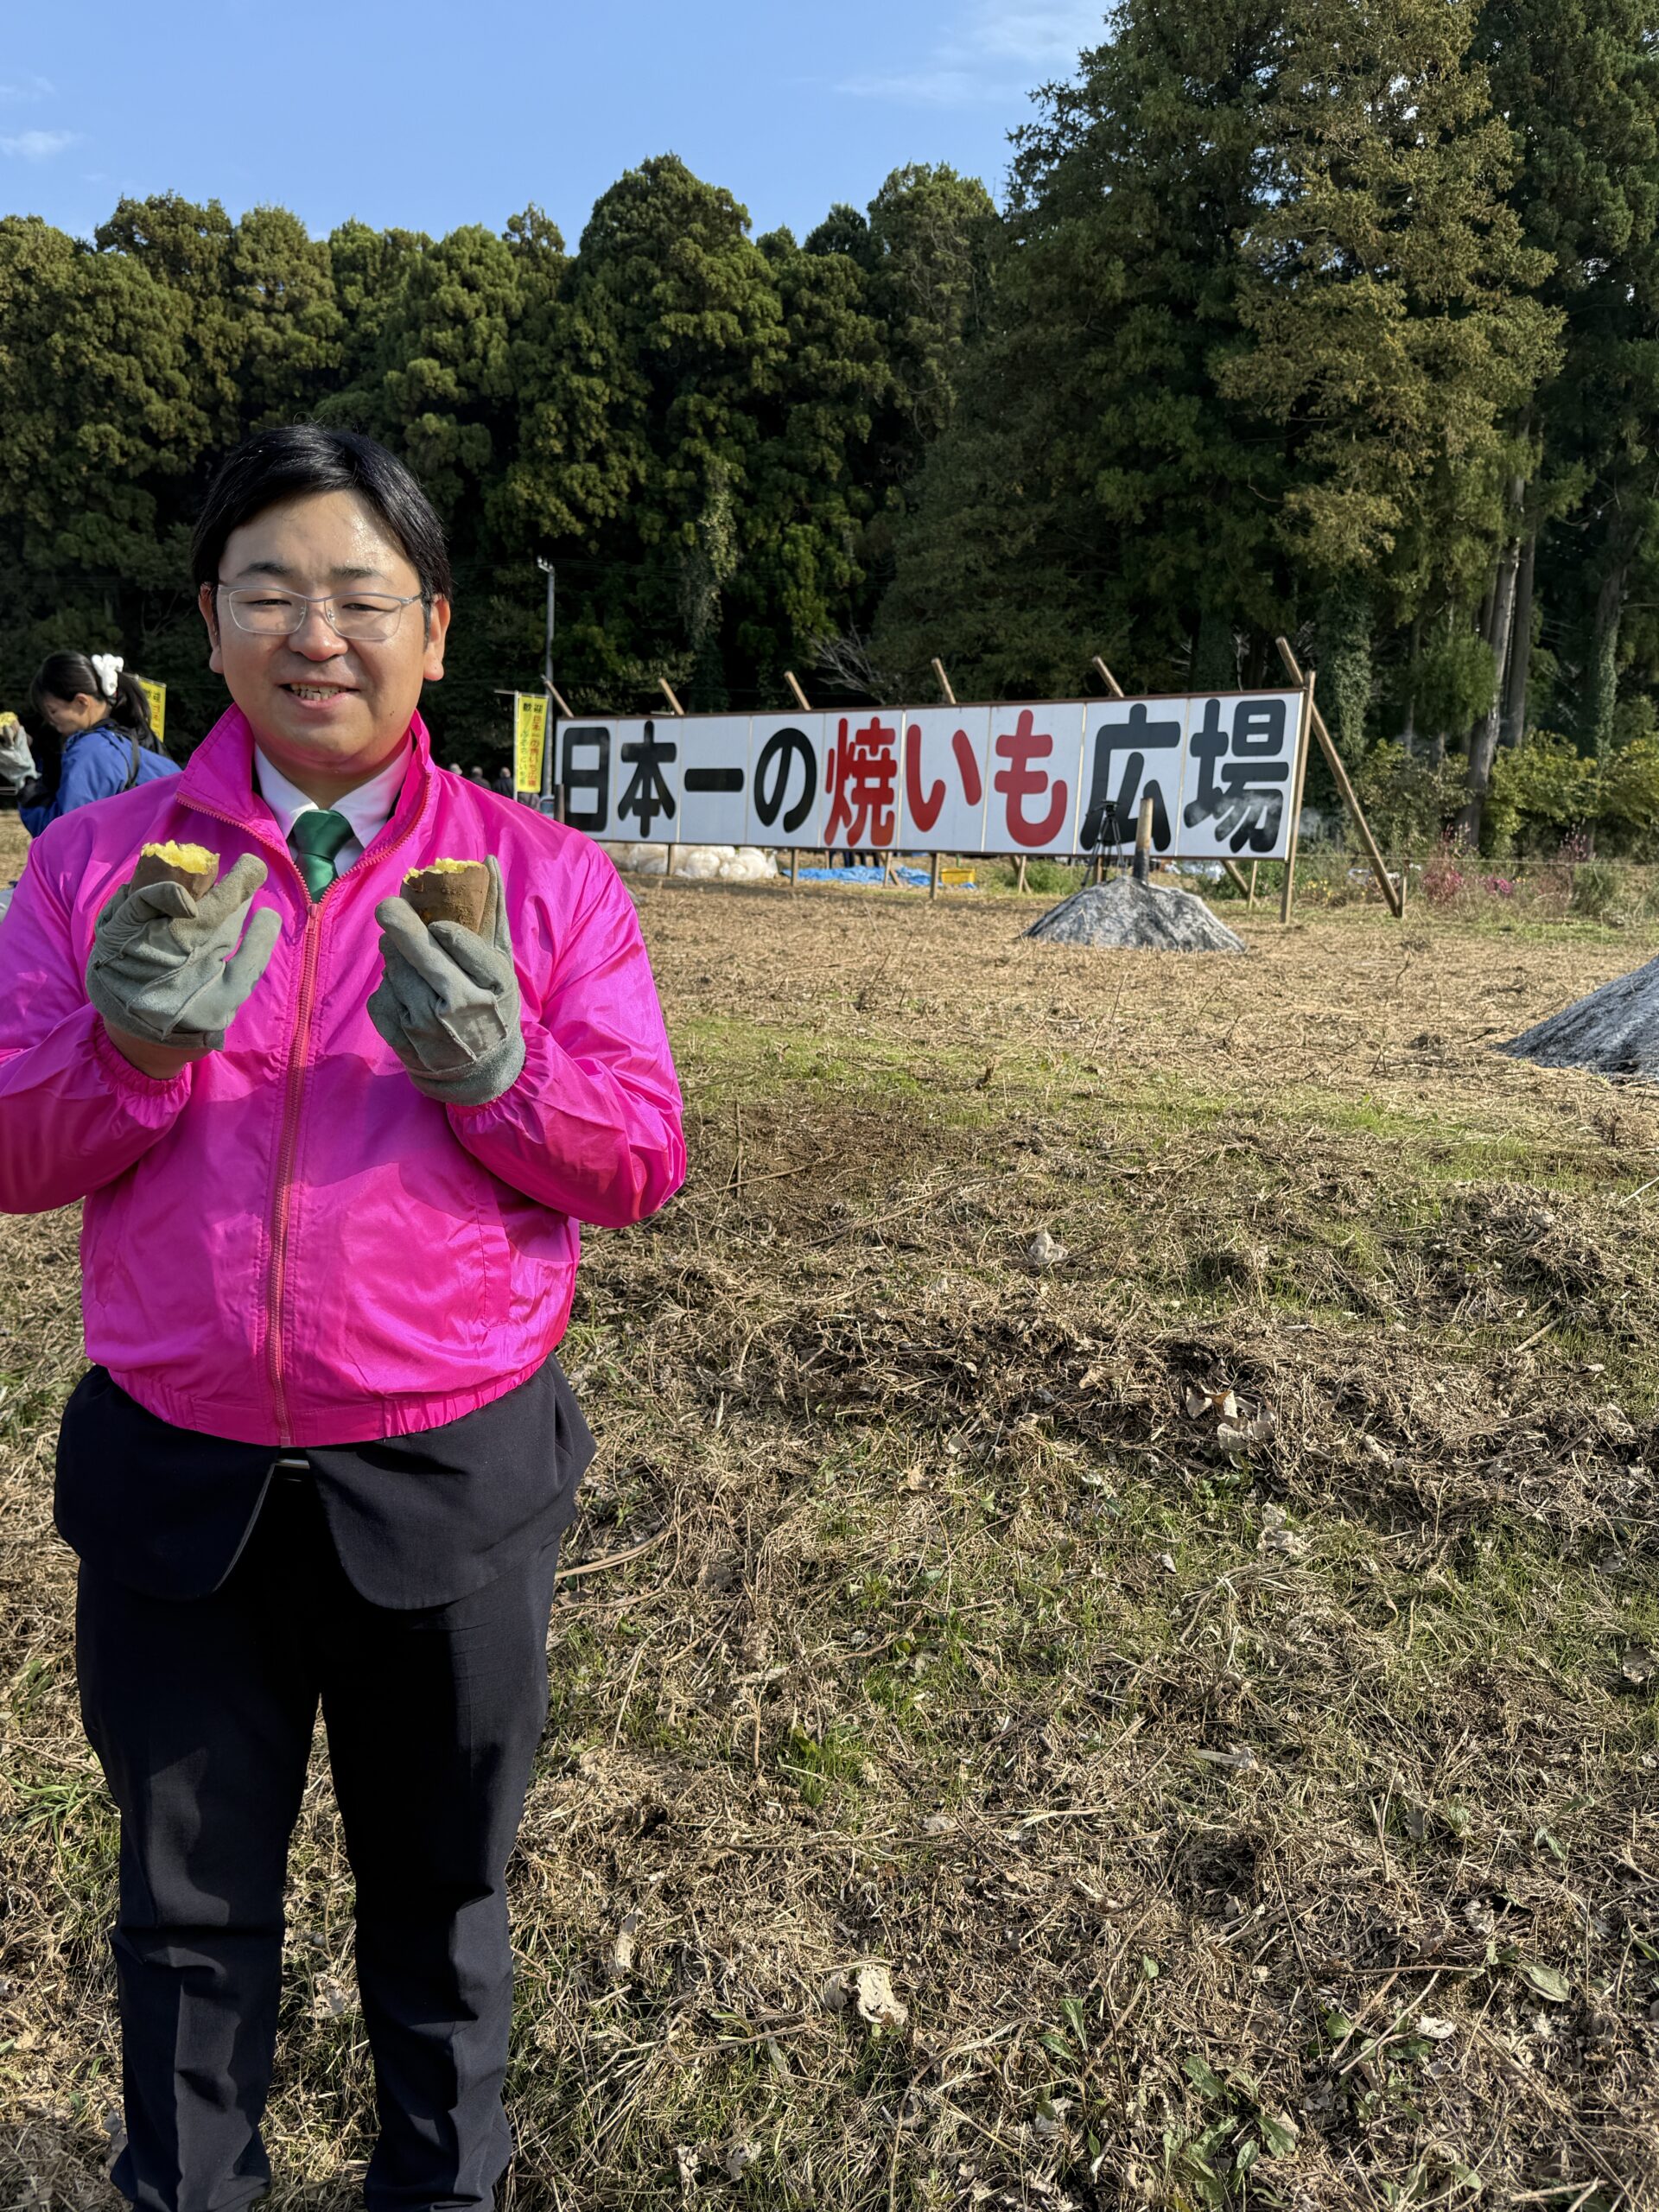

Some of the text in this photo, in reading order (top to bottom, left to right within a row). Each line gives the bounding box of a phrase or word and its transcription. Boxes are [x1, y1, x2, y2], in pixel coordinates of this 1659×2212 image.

[562, 698, 1289, 854] 日本一の焼いも広場
